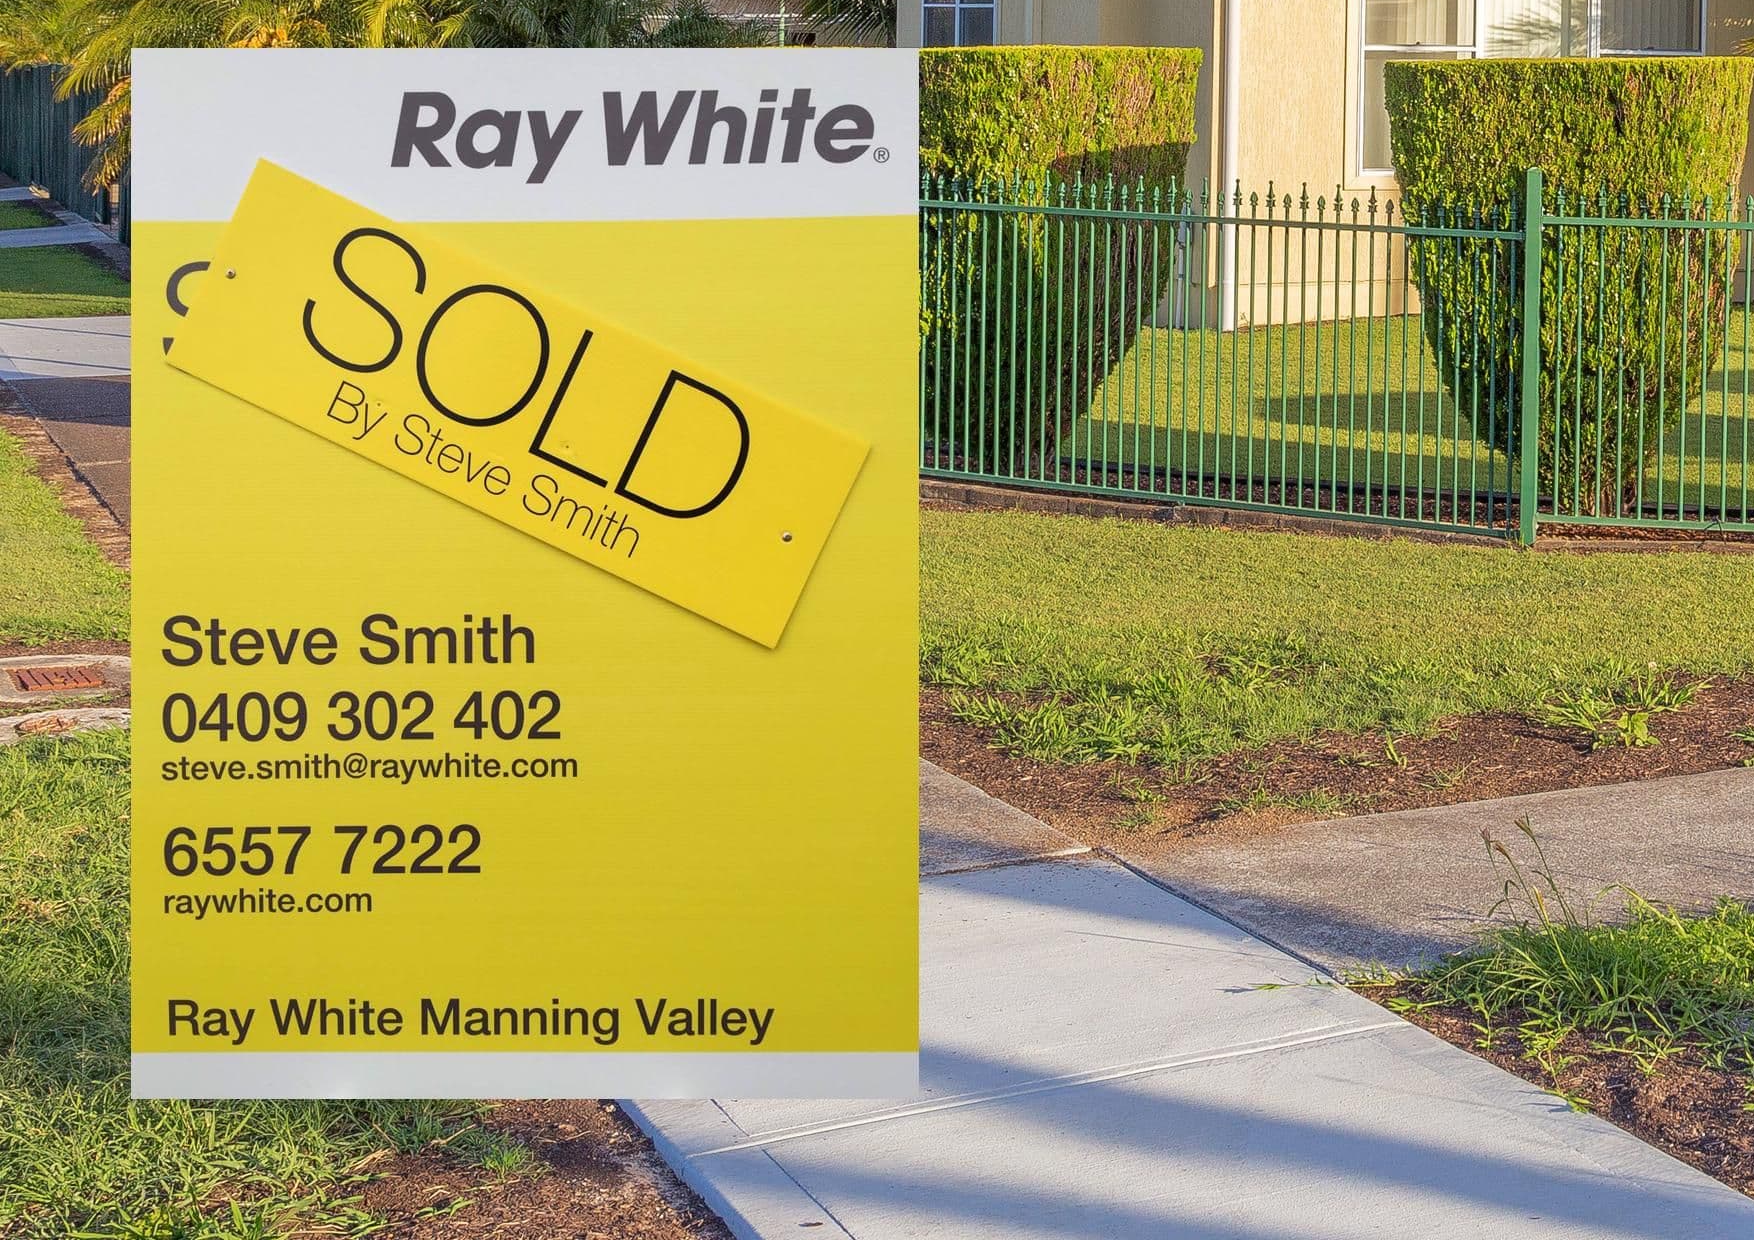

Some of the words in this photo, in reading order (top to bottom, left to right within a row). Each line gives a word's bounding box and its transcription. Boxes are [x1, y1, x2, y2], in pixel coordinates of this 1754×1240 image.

[391, 92, 583, 183] Ray
[603, 88, 874, 167] White
[303, 228, 749, 518] SOLD
[326, 380, 387, 441] By
[395, 415, 510, 496] Steve
[523, 475, 640, 558] Smith
[162, 615, 337, 666] Steve
[360, 614, 534, 665] Smith
[163, 692, 307, 743] 0409
[328, 691, 433, 741] 302
[454, 690, 560, 740] 402
[162, 753, 577, 784] steve.smith@raywhite.com
[164, 826, 311, 876] 6557
[335, 824, 480, 875] 7222
[165, 888, 371, 920] raywhite.com
[169, 1000, 255, 1045] Ray
[270, 999, 403, 1036] White
[421, 999, 619, 1045] Manning
[635, 999, 774, 1045] Valley
